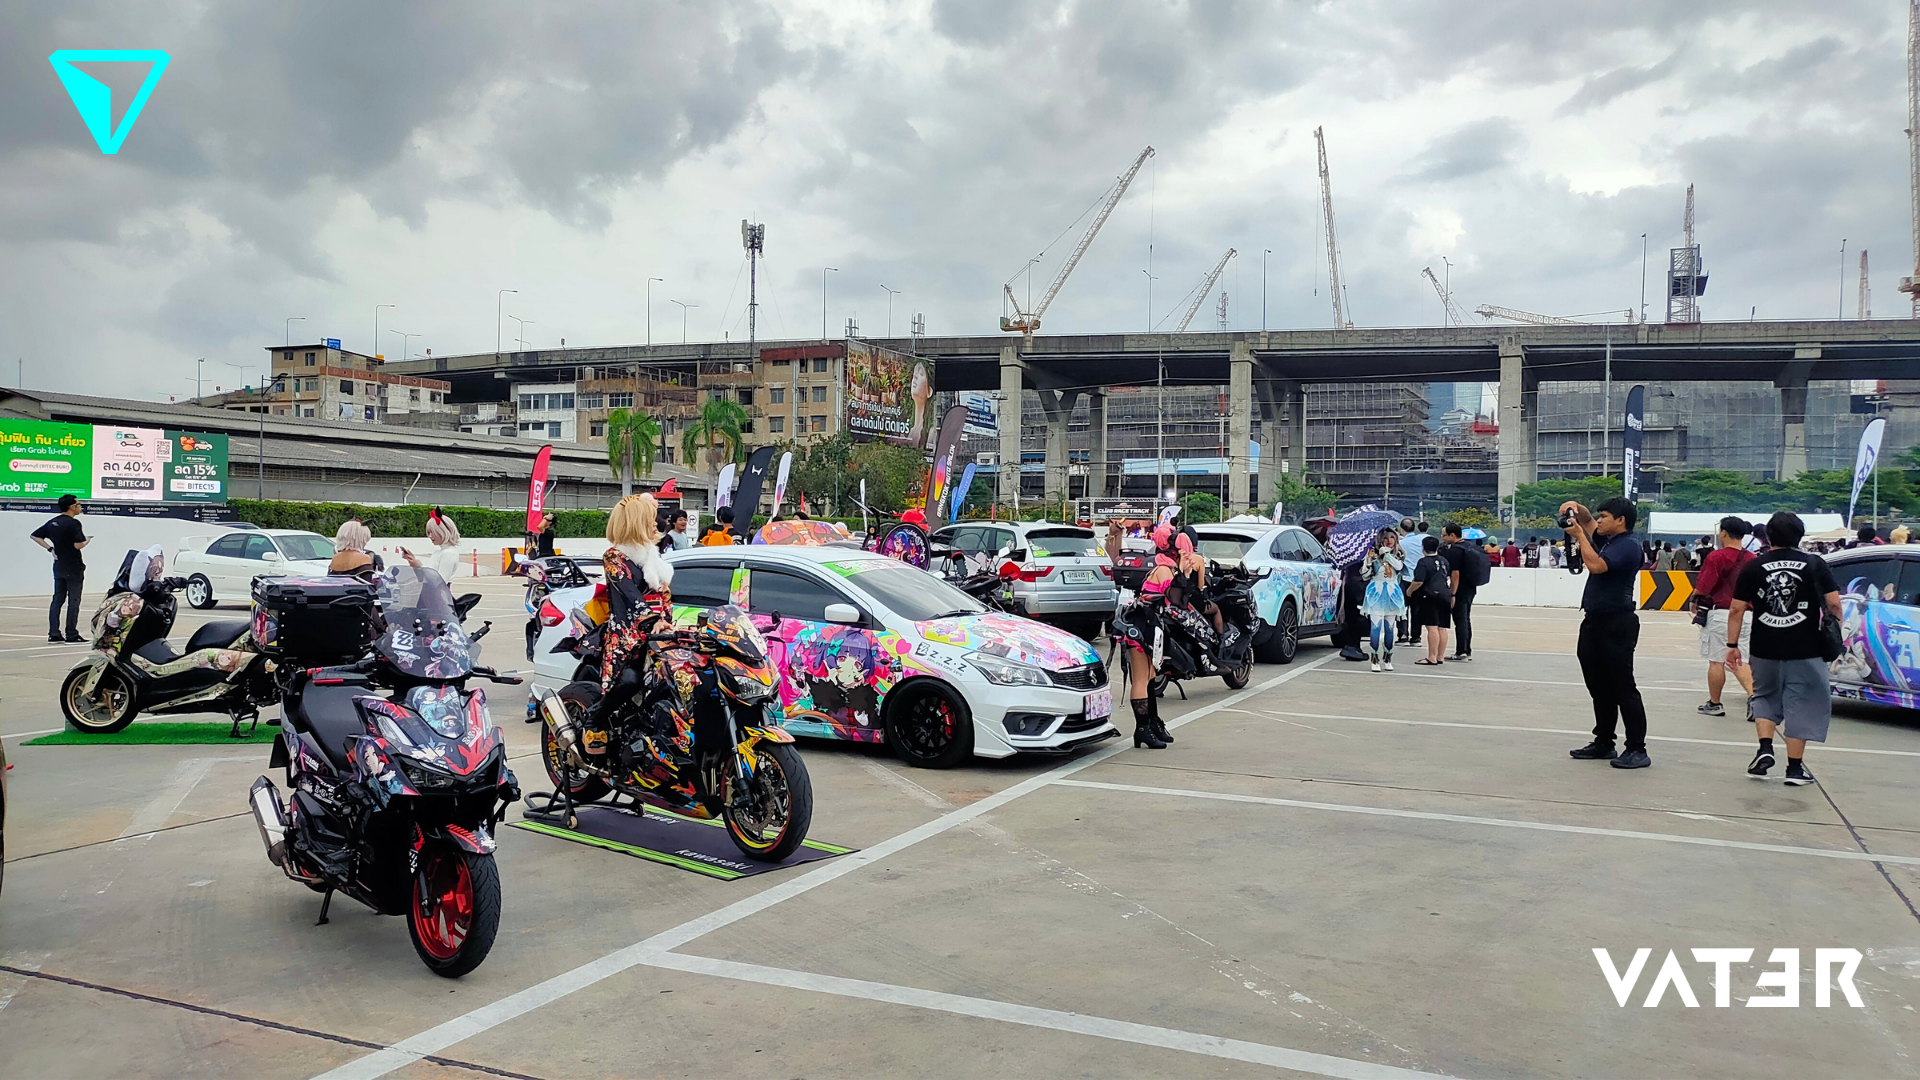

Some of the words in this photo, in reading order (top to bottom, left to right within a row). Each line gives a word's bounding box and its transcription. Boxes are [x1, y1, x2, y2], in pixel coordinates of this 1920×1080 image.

[35, 434, 52, 445] กิน
[60, 433, 86, 447] เที่ยว
[103, 462, 120, 471] ลด
[174, 465, 190, 474] ลด
[936, 486, 950, 518] BANGKOK
[946, 444, 956, 466] SALON
[0, 482, 20, 492] rab
[534, 483, 542, 508] LEO
[1766, 562, 1802, 570] ITASHA
[1763, 615, 1801, 625] THAILAND
